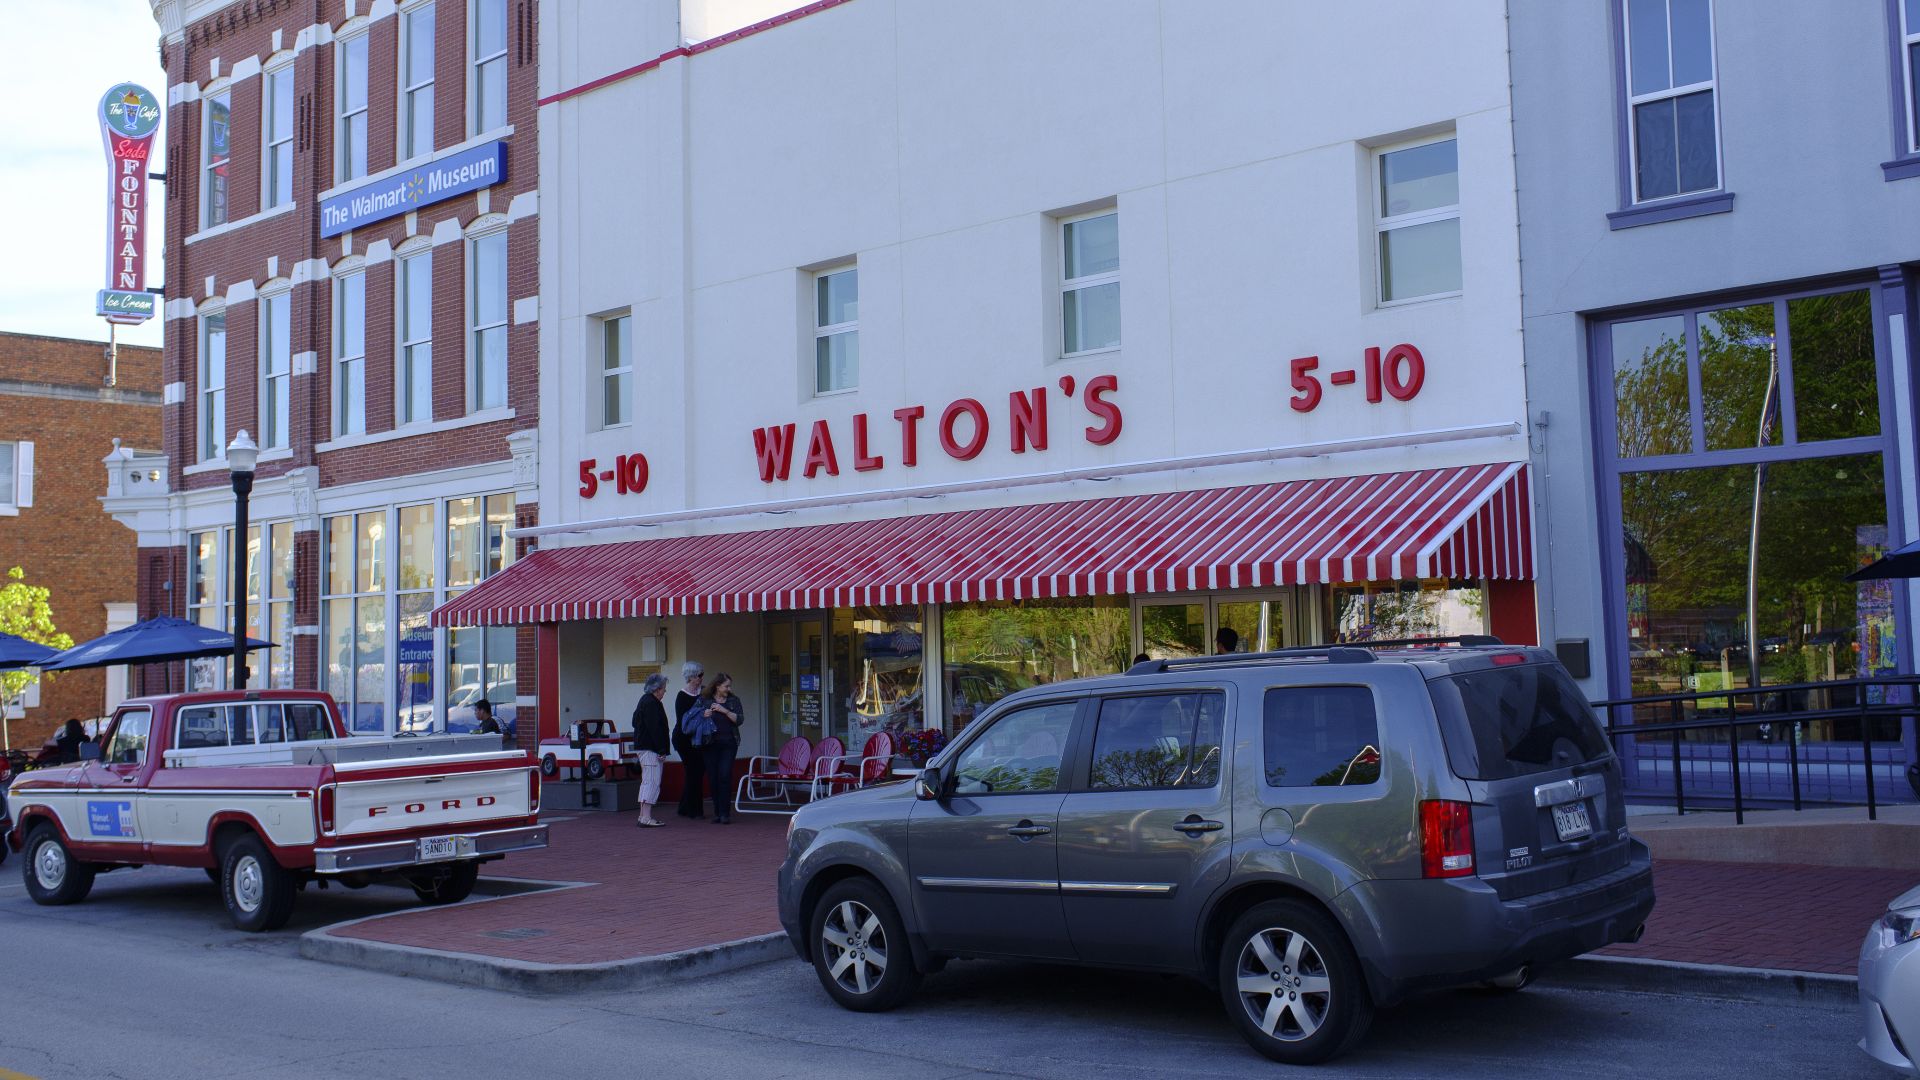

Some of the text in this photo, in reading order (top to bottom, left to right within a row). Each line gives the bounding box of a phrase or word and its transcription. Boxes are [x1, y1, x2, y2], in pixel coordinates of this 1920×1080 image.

[109, 103, 123, 115] The
[114, 140, 147, 159] Soda
[324, 156, 496, 228] The Walmart Museum
[120, 158, 139, 289] FOUNTAIN
[105, 294, 153, 308] Ice Cream
[1290, 343, 1426, 413] 5-10
[752, 374, 1123, 484] WALTON'S
[579, 452, 649, 499] 5-10
[368, 796, 496, 817] FORD
[1506, 855, 1533, 869] PILOT
